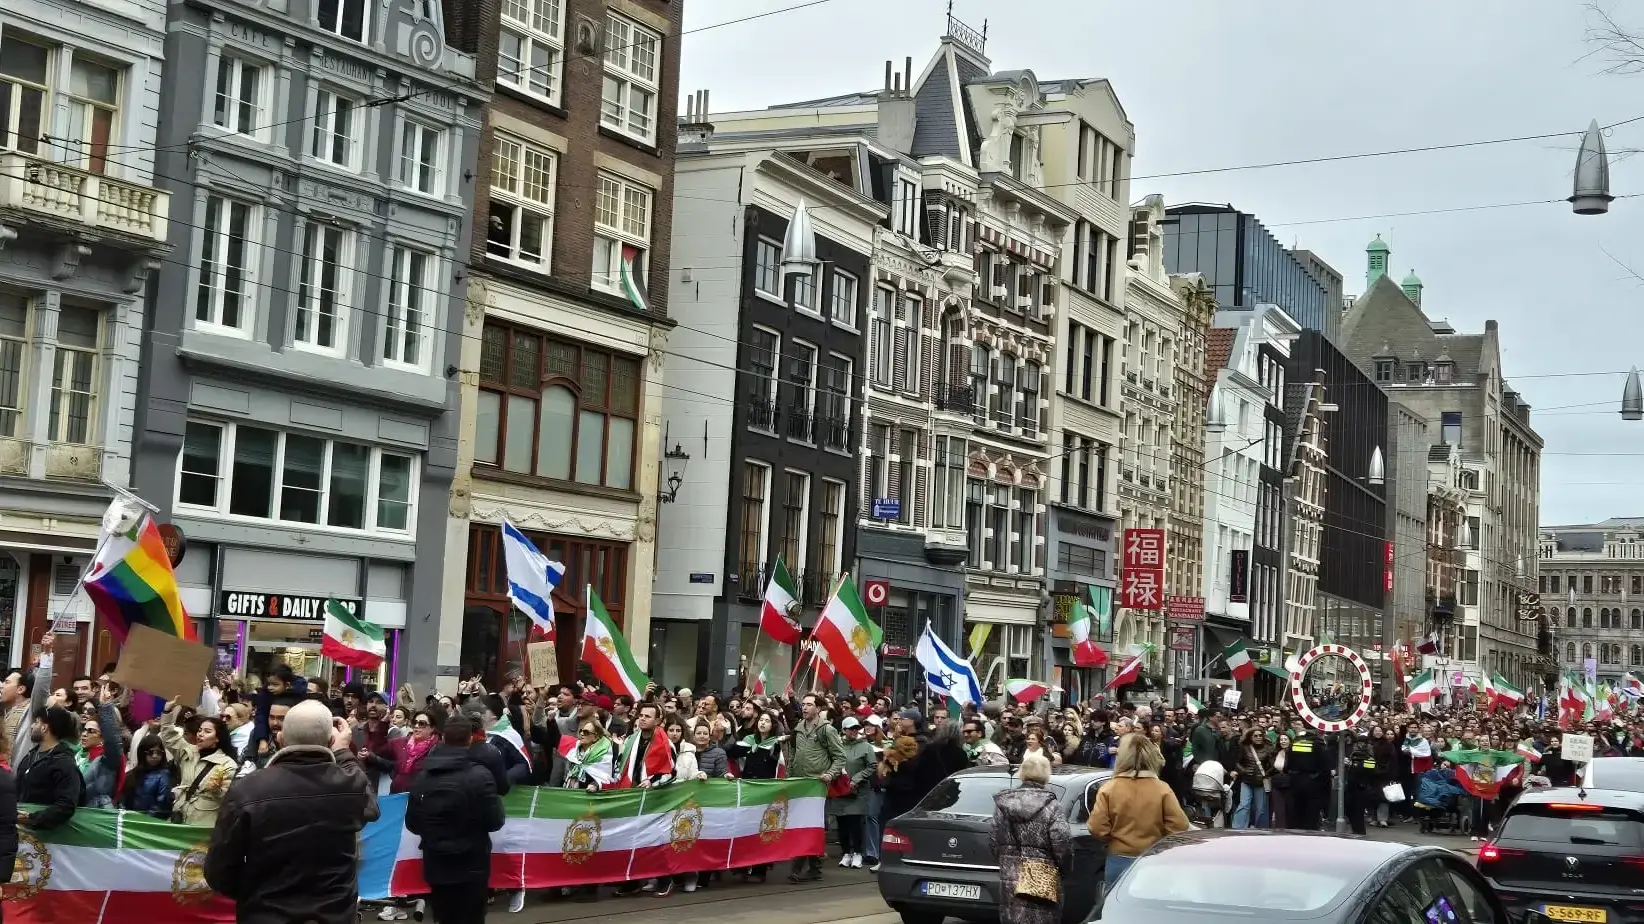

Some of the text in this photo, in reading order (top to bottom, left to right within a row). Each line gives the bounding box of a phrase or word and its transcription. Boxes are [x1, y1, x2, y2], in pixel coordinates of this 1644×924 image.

[319, 55, 372, 83] RESTAURANT
[425, 91, 453, 110] POOL
[227, 593, 356, 618] GIFTS & DAILY SP
[1548, 907, 1602, 920] S-569-RF
